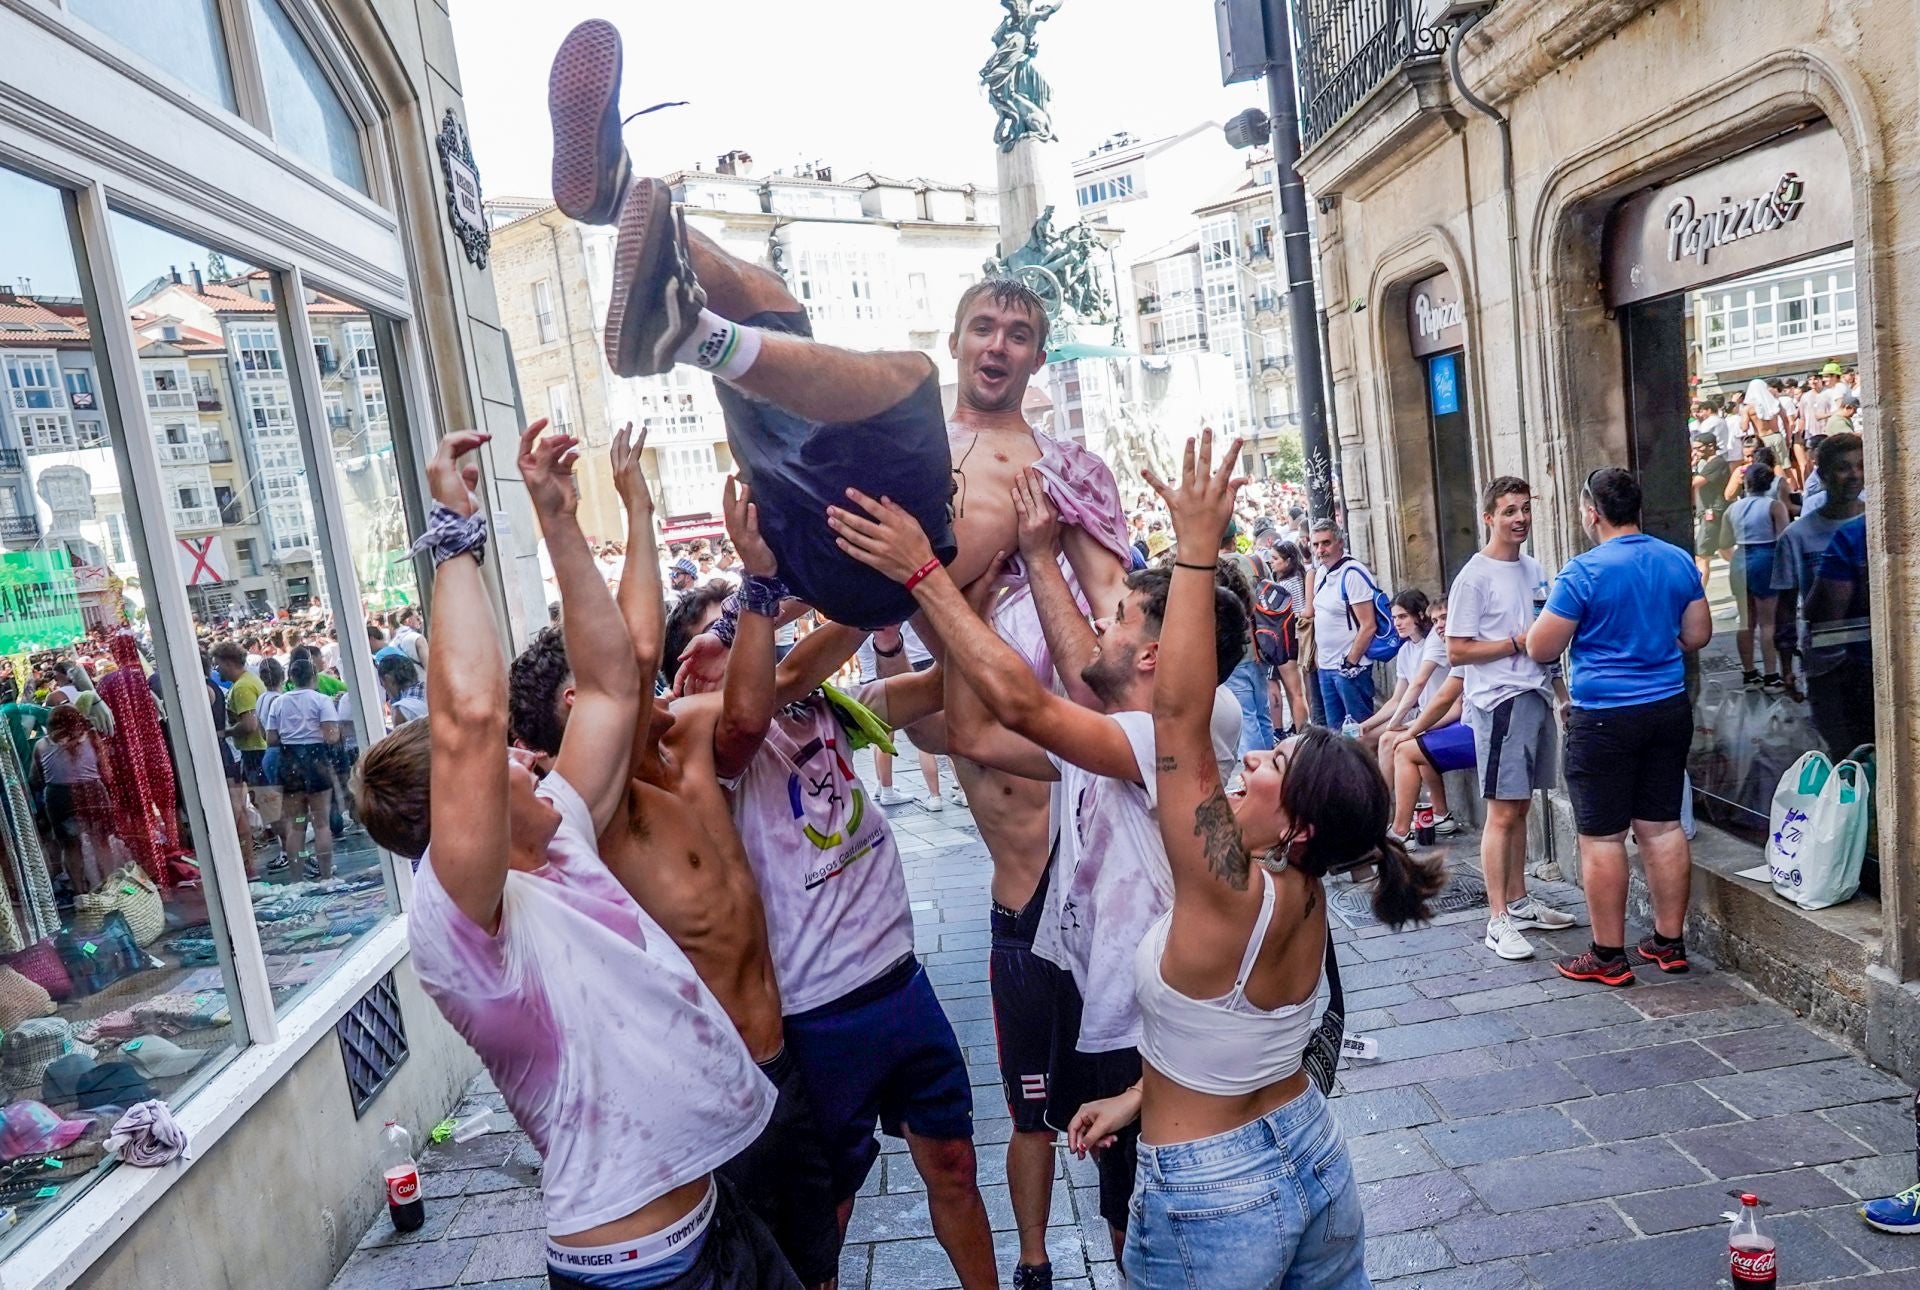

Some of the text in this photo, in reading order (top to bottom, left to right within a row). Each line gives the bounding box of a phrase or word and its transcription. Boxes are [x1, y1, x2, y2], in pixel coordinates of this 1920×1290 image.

[1665, 194, 1783, 265] Papizza
[804, 861, 838, 885] Juegos
[1021, 1074, 1049, 1099] 2
[398, 1183, 415, 1195] Cola
[665, 1217, 695, 1248] TOMMY
[567, 1253, 613, 1267] HILFIGER
